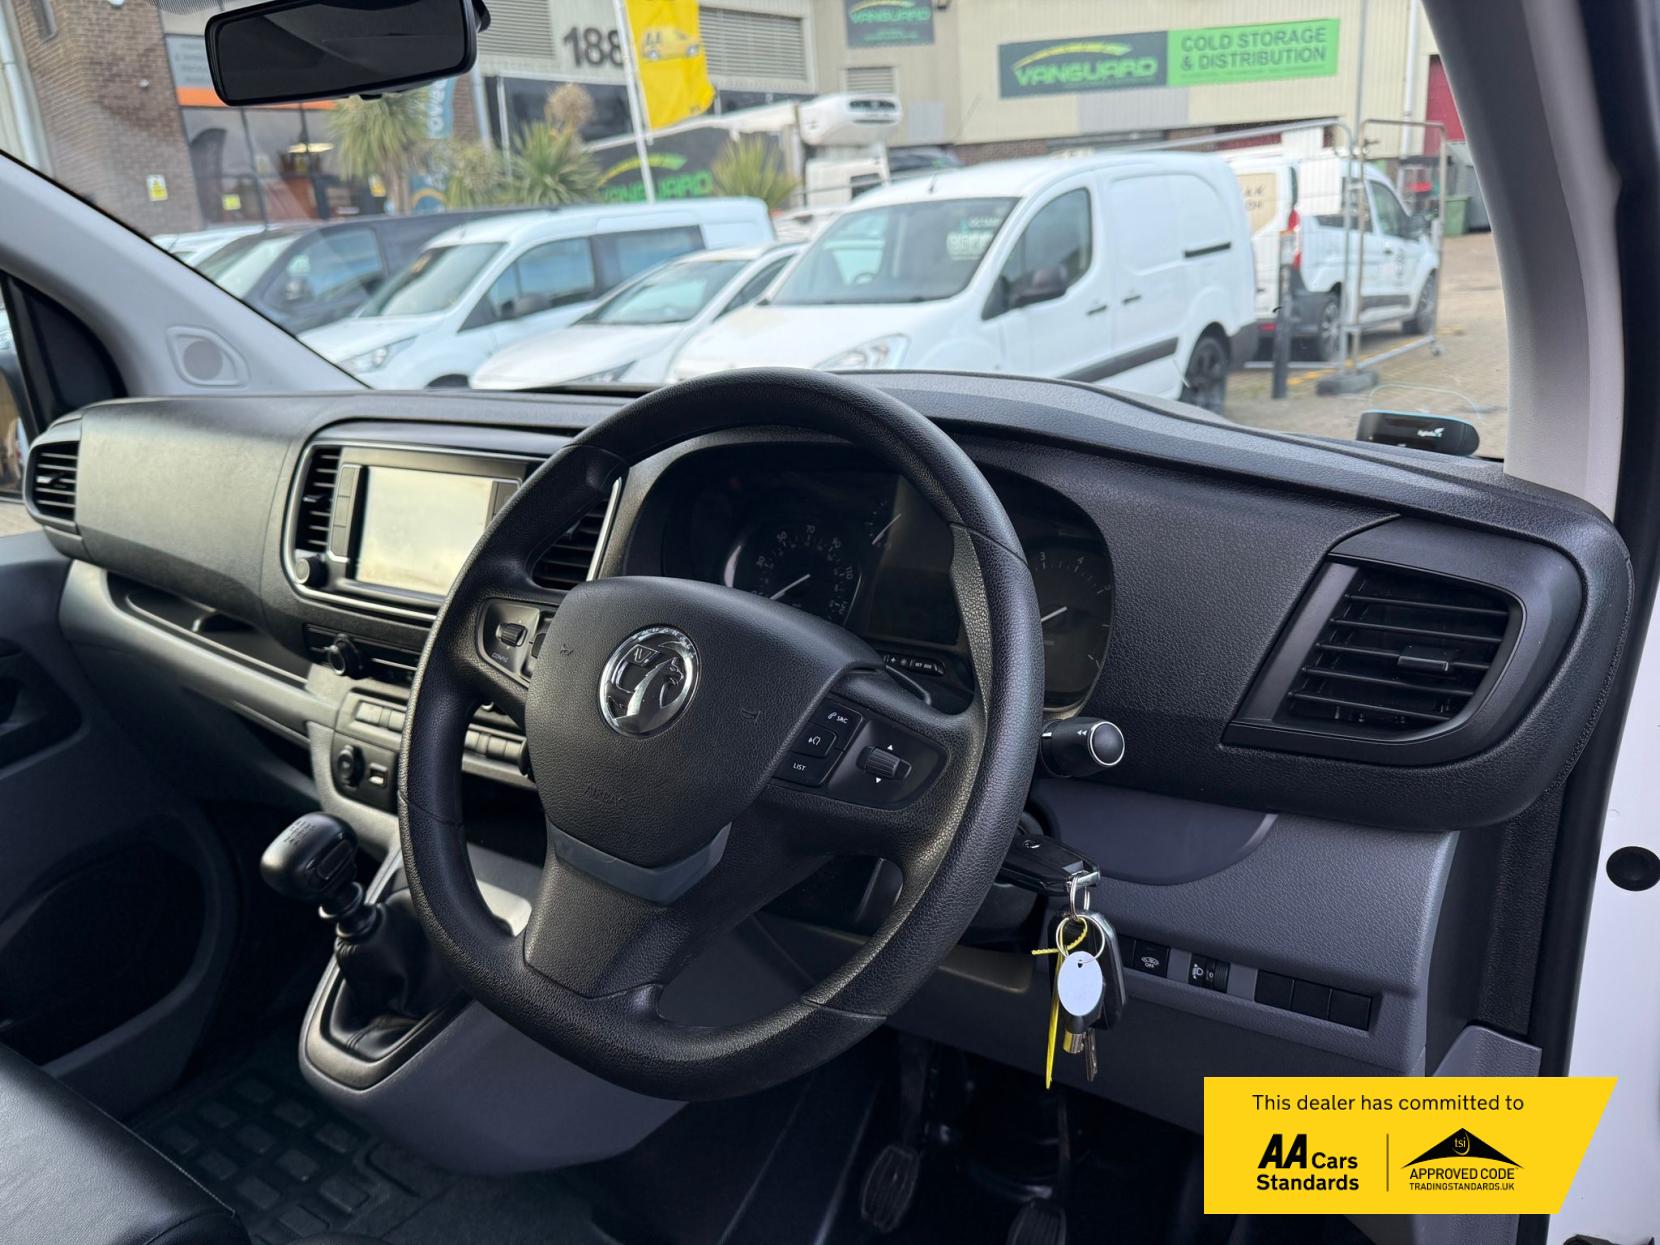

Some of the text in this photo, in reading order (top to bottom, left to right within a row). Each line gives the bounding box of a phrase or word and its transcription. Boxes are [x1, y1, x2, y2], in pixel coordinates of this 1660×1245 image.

[1181, 27, 1327, 52] COLD STORAGE
[1014, 56, 1158, 86] VANGUARD
[1181, 46, 1326, 71] & DISTRIBUTION
[792, 762, 807, 772] LIST
